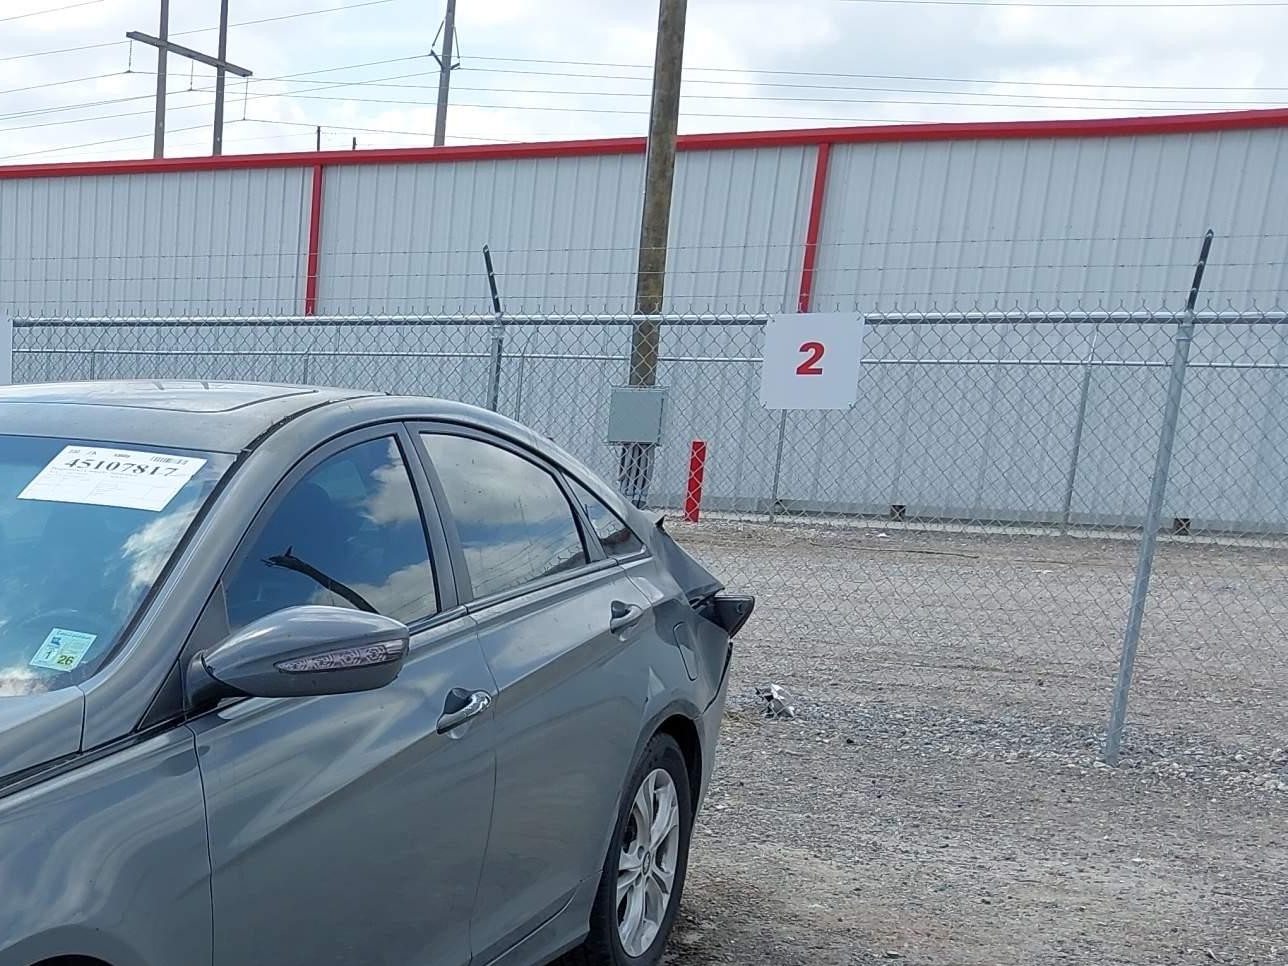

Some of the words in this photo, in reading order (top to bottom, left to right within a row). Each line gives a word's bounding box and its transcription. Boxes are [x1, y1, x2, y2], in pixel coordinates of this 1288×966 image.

[796, 341, 825, 375] 2
[64, 458, 179, 477] 45107817
[57, 655, 74, 665] 26
